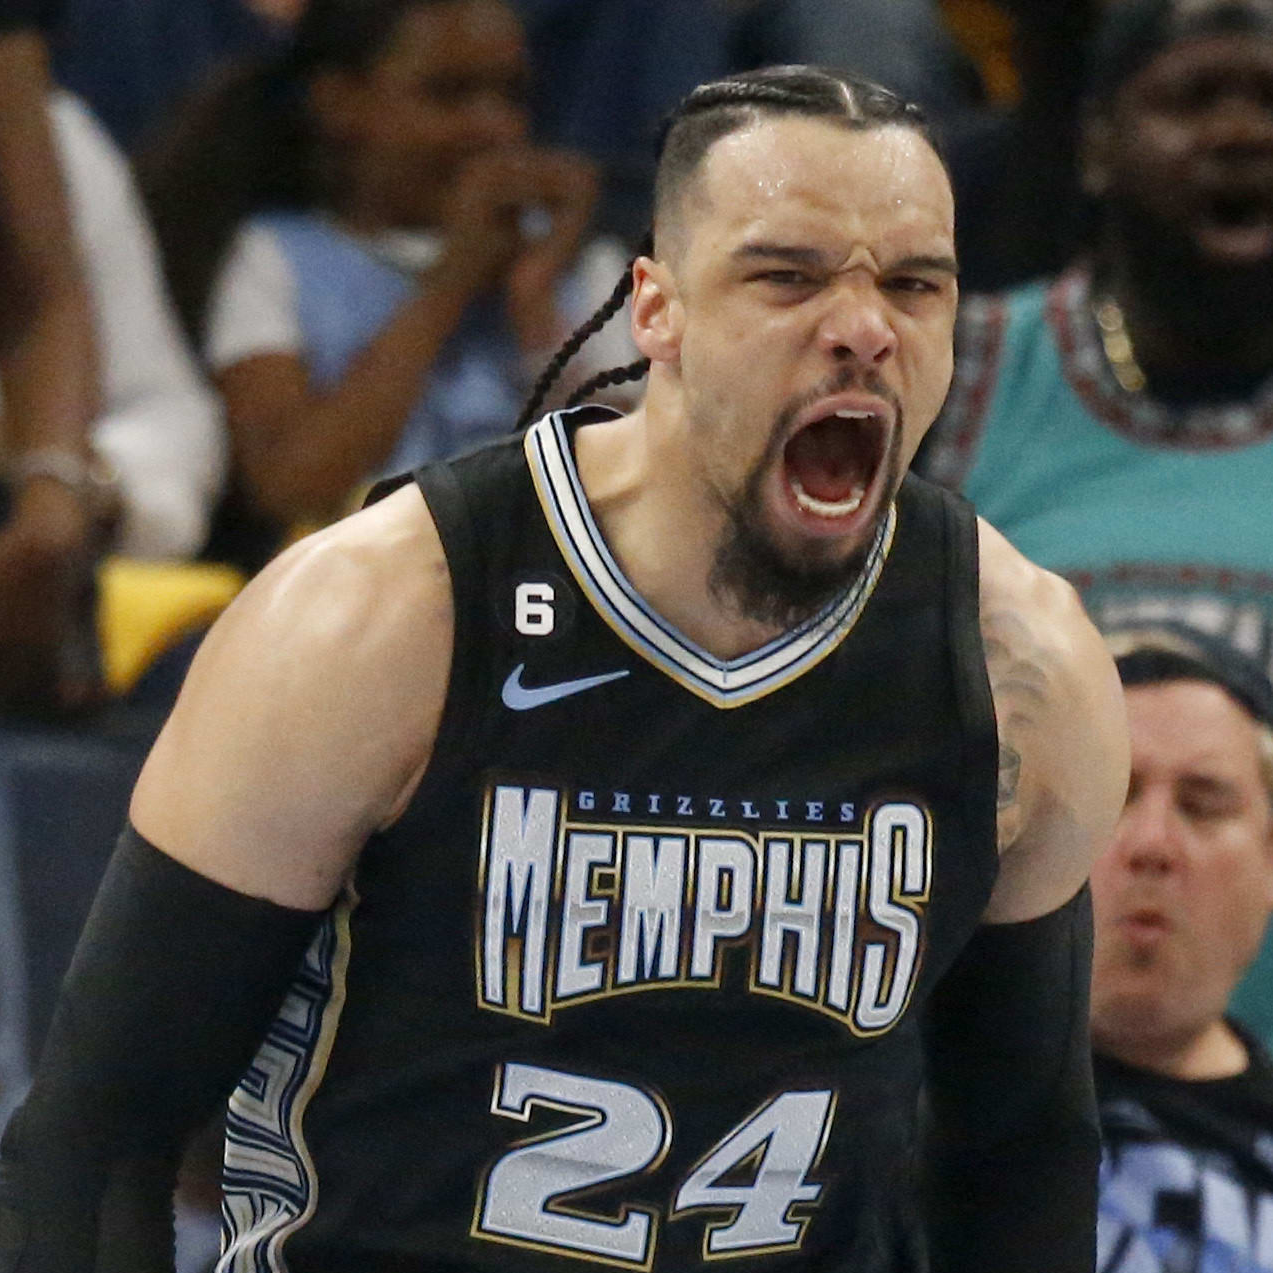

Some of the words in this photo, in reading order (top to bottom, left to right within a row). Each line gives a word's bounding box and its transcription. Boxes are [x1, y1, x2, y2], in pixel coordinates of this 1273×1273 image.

[515, 583, 555, 636] 6
[578, 791, 855, 822] GRIZZLIES
[477, 785, 933, 1037] MEMPHIS
[471, 1062, 838, 1272] 24
